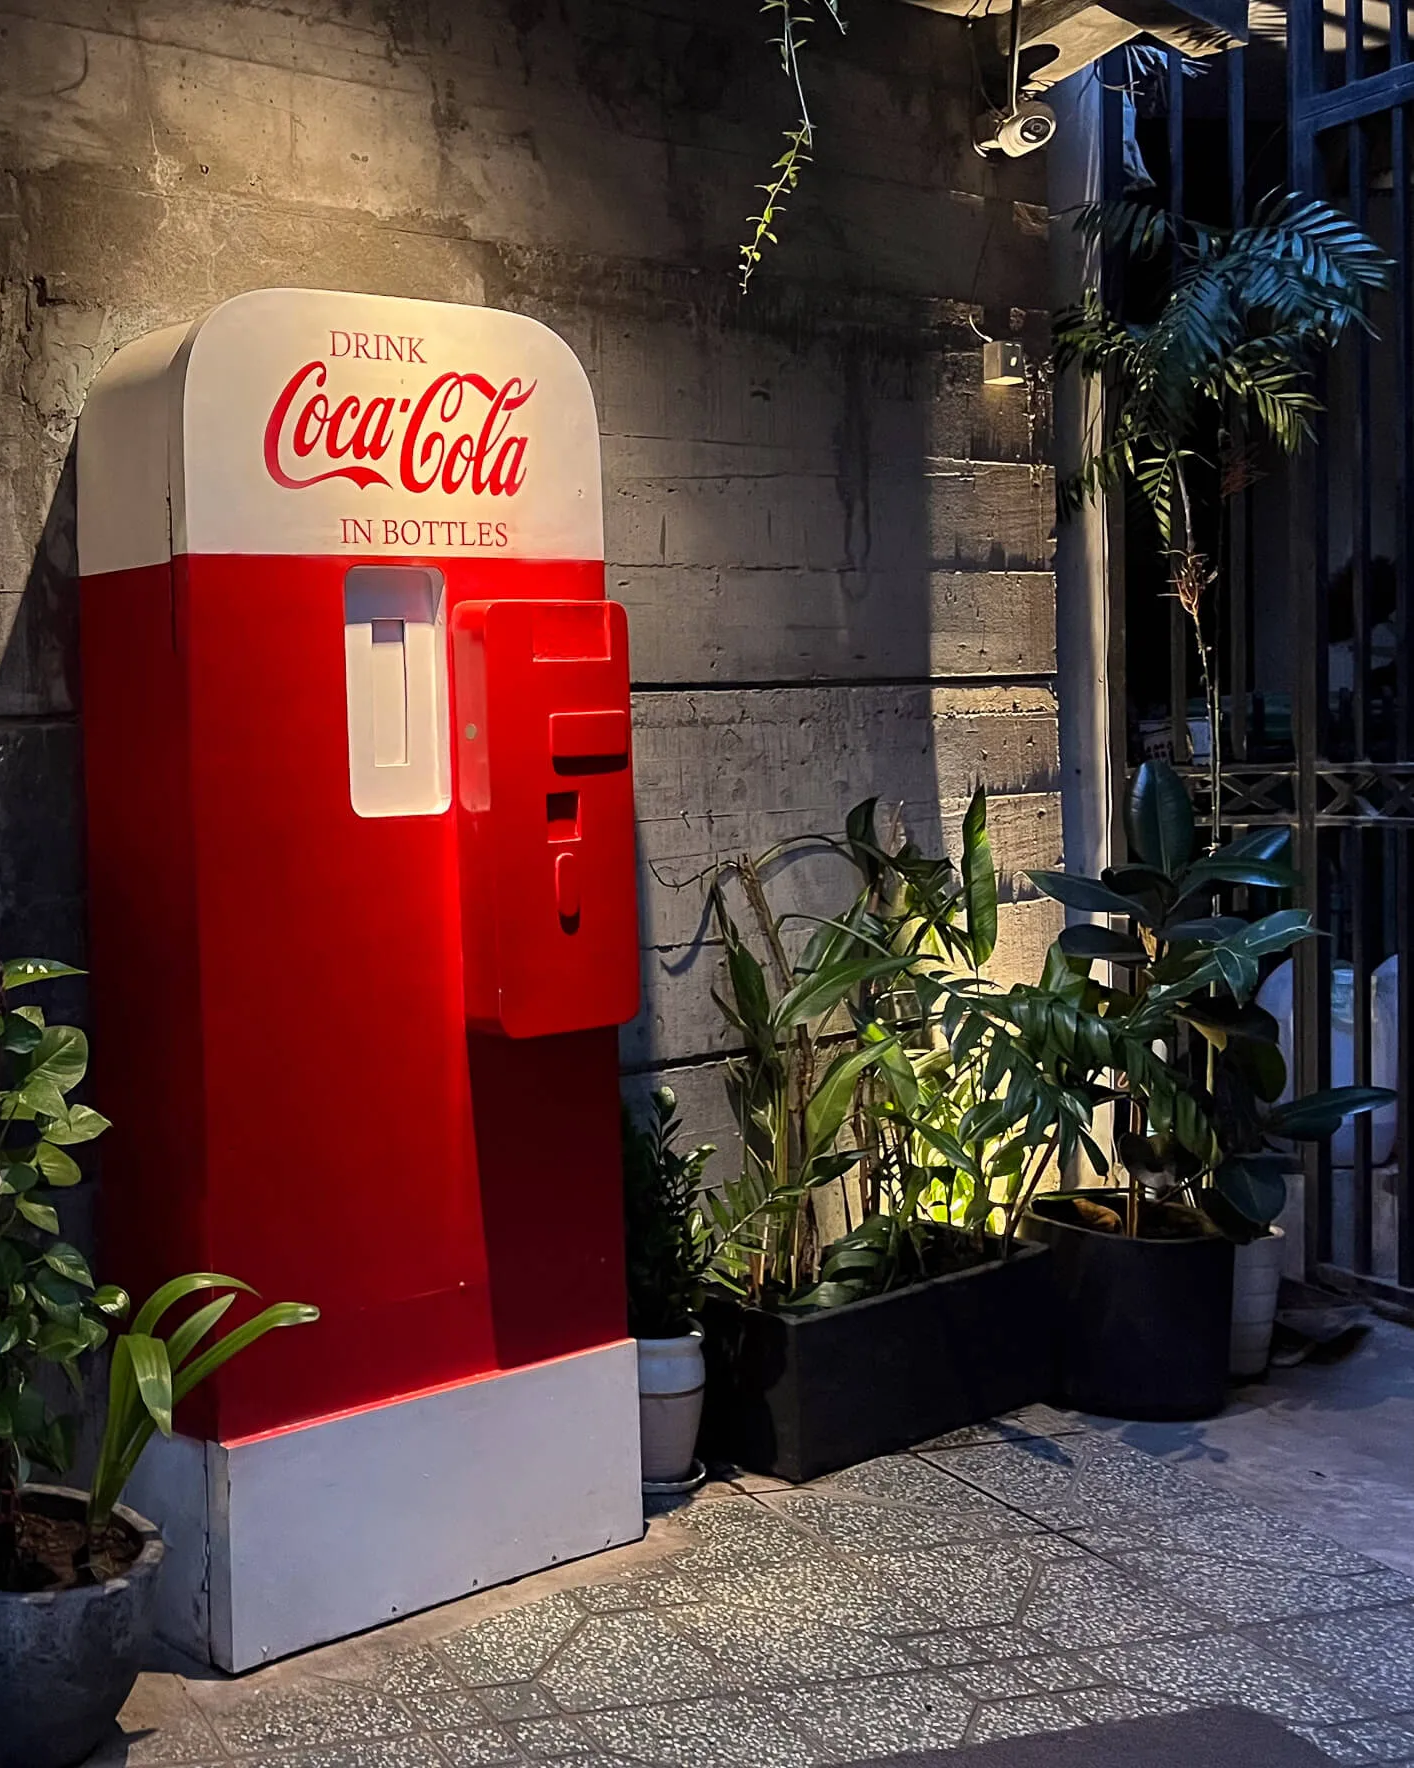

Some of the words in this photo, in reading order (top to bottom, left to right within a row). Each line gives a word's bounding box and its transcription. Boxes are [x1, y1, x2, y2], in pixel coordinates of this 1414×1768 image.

[329, 330, 427, 364] DRINK
[340, 518, 373, 544] IN
[382, 519, 509, 548] BOTTLES
